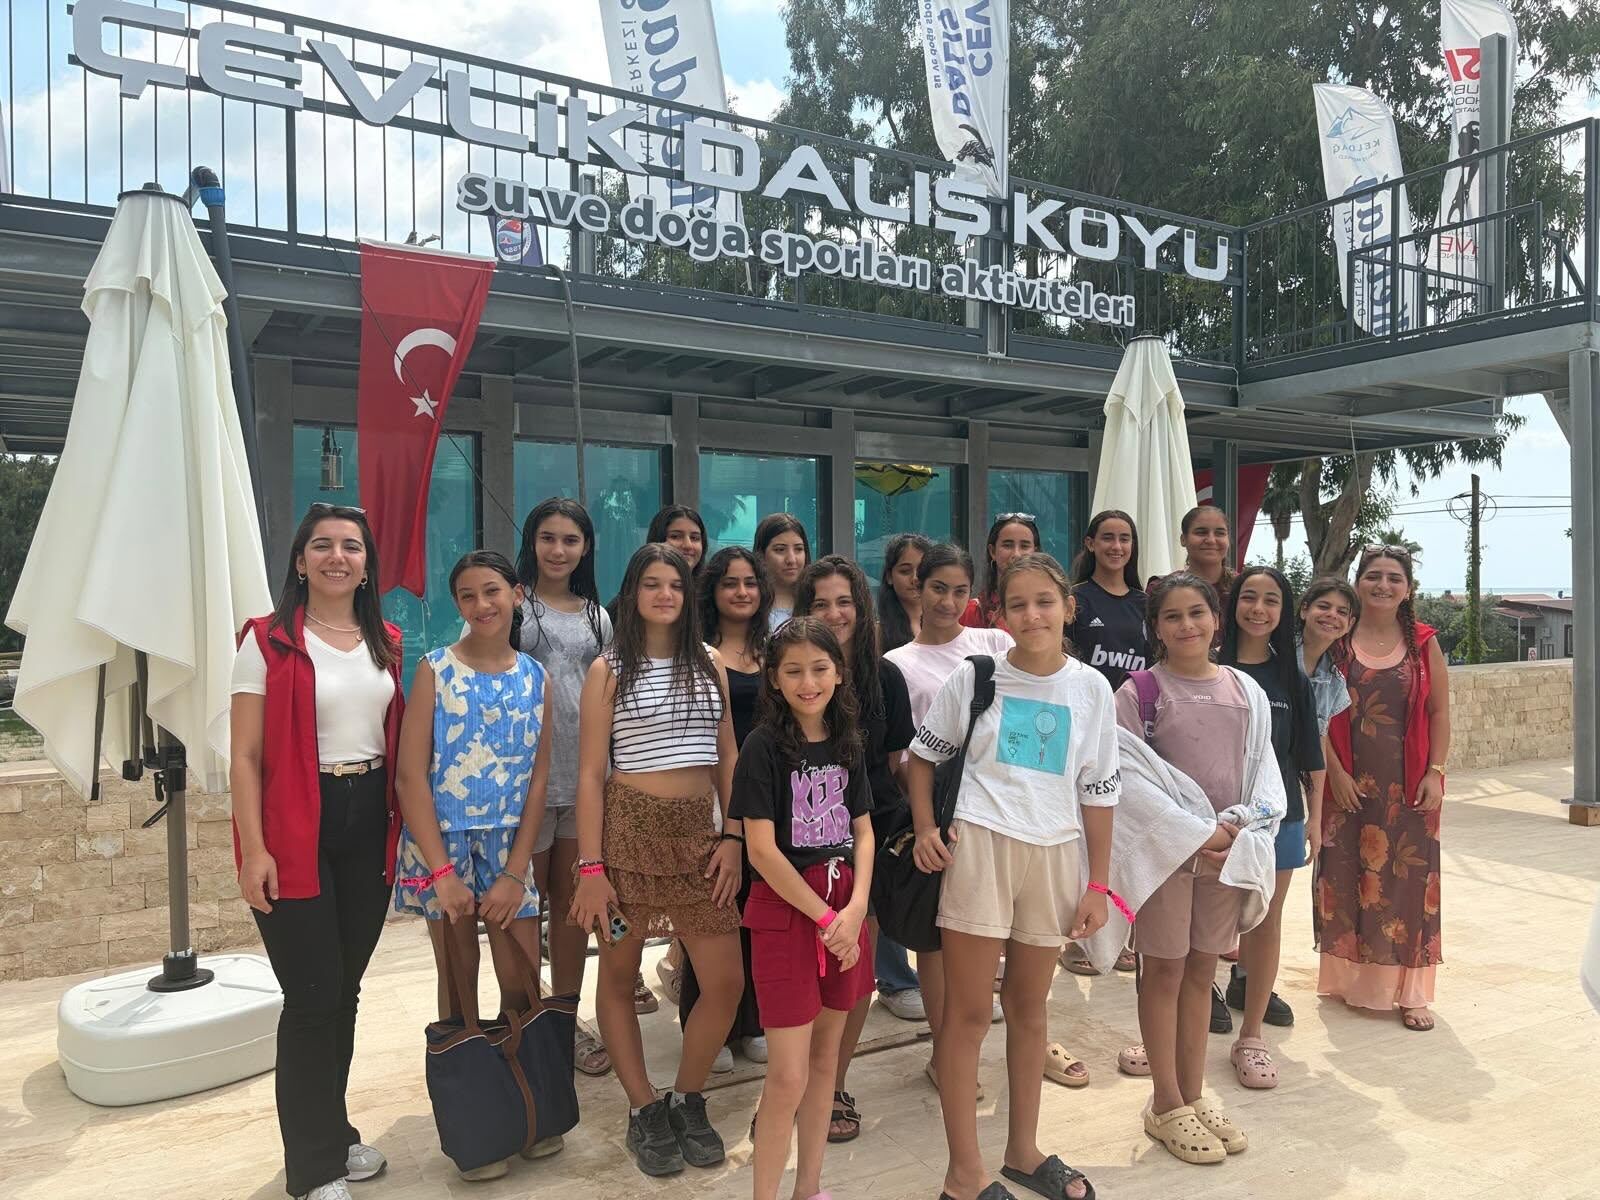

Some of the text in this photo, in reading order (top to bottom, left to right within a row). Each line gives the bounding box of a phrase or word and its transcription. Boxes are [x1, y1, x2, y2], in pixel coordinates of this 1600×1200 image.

[457, 172, 1135, 327] su ve doğa sporları aktiviteleri
[683, 121, 990, 246] DALIŞ
[1013, 192, 1229, 282] KÖYÜ
[1090, 643, 1147, 671] bwin
